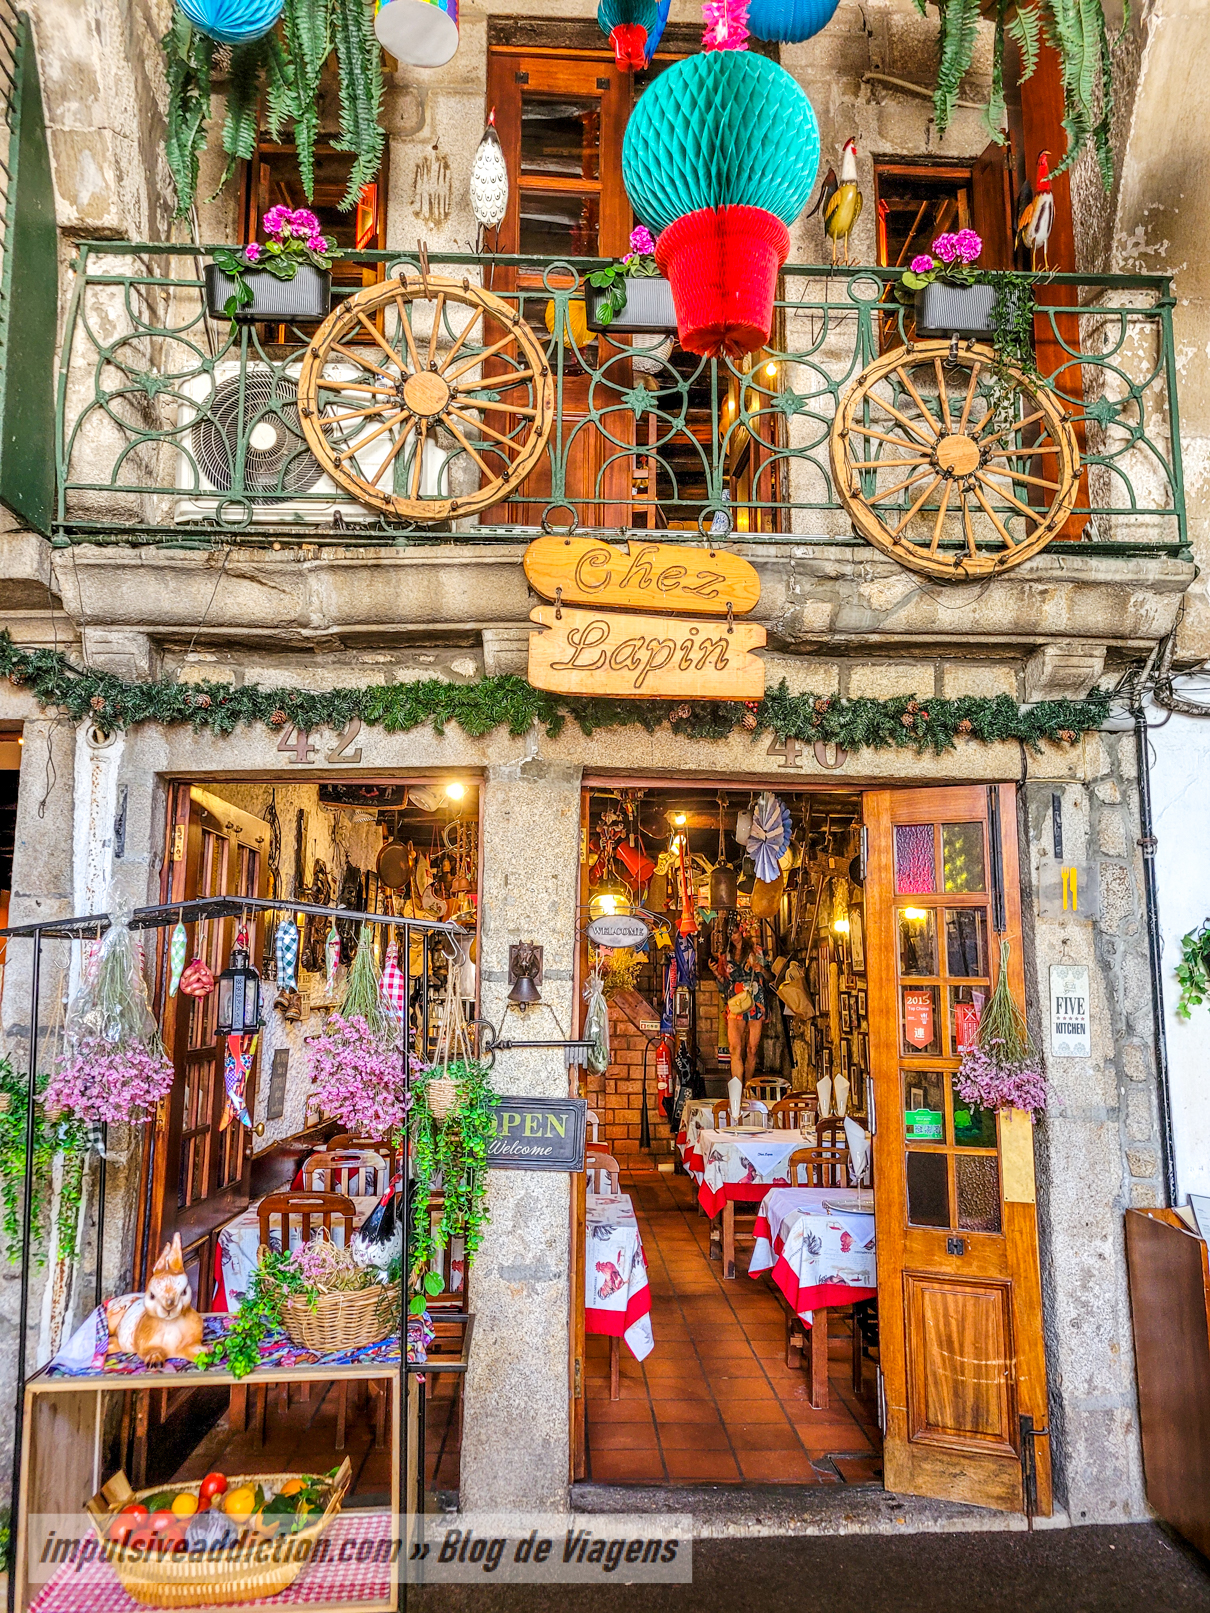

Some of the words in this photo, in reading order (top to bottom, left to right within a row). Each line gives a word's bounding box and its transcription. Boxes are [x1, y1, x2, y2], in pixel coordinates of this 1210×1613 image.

[575, 546, 726, 599] Chez
[550, 620, 729, 689] Lapin
[277, 716, 363, 764] 42
[766, 731, 849, 769] 40
[592, 926, 644, 937] WELCOME
[906, 993, 930, 1005] 2015
[1056, 996, 1085, 1015] FIVE
[1056, 1022, 1086, 1035] KITCHEN
[488, 1140, 553, 1156] Welcome
